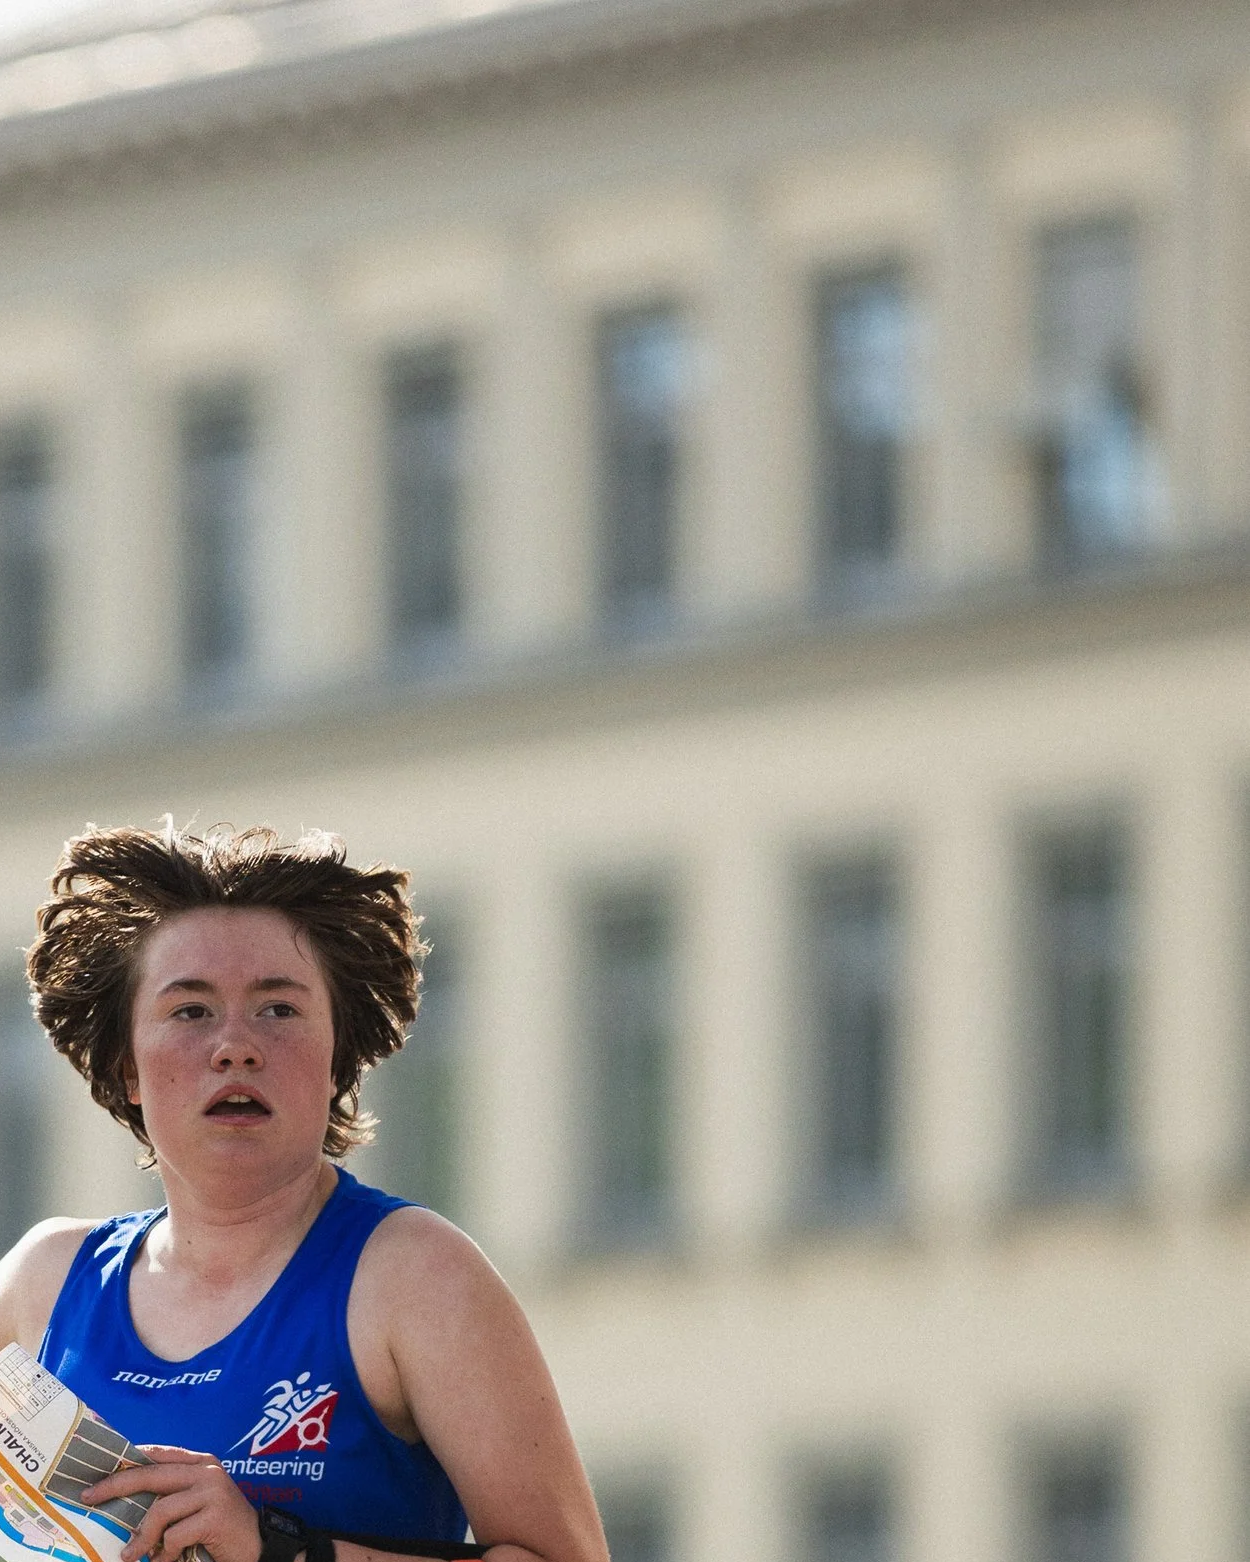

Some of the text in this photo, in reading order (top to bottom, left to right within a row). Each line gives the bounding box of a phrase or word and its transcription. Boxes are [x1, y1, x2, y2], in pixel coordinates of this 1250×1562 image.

[112, 1369, 222, 1388] noname
[23, 1435, 47, 1464] TEKNISKA
[221, 1456, 325, 1481] enteering
